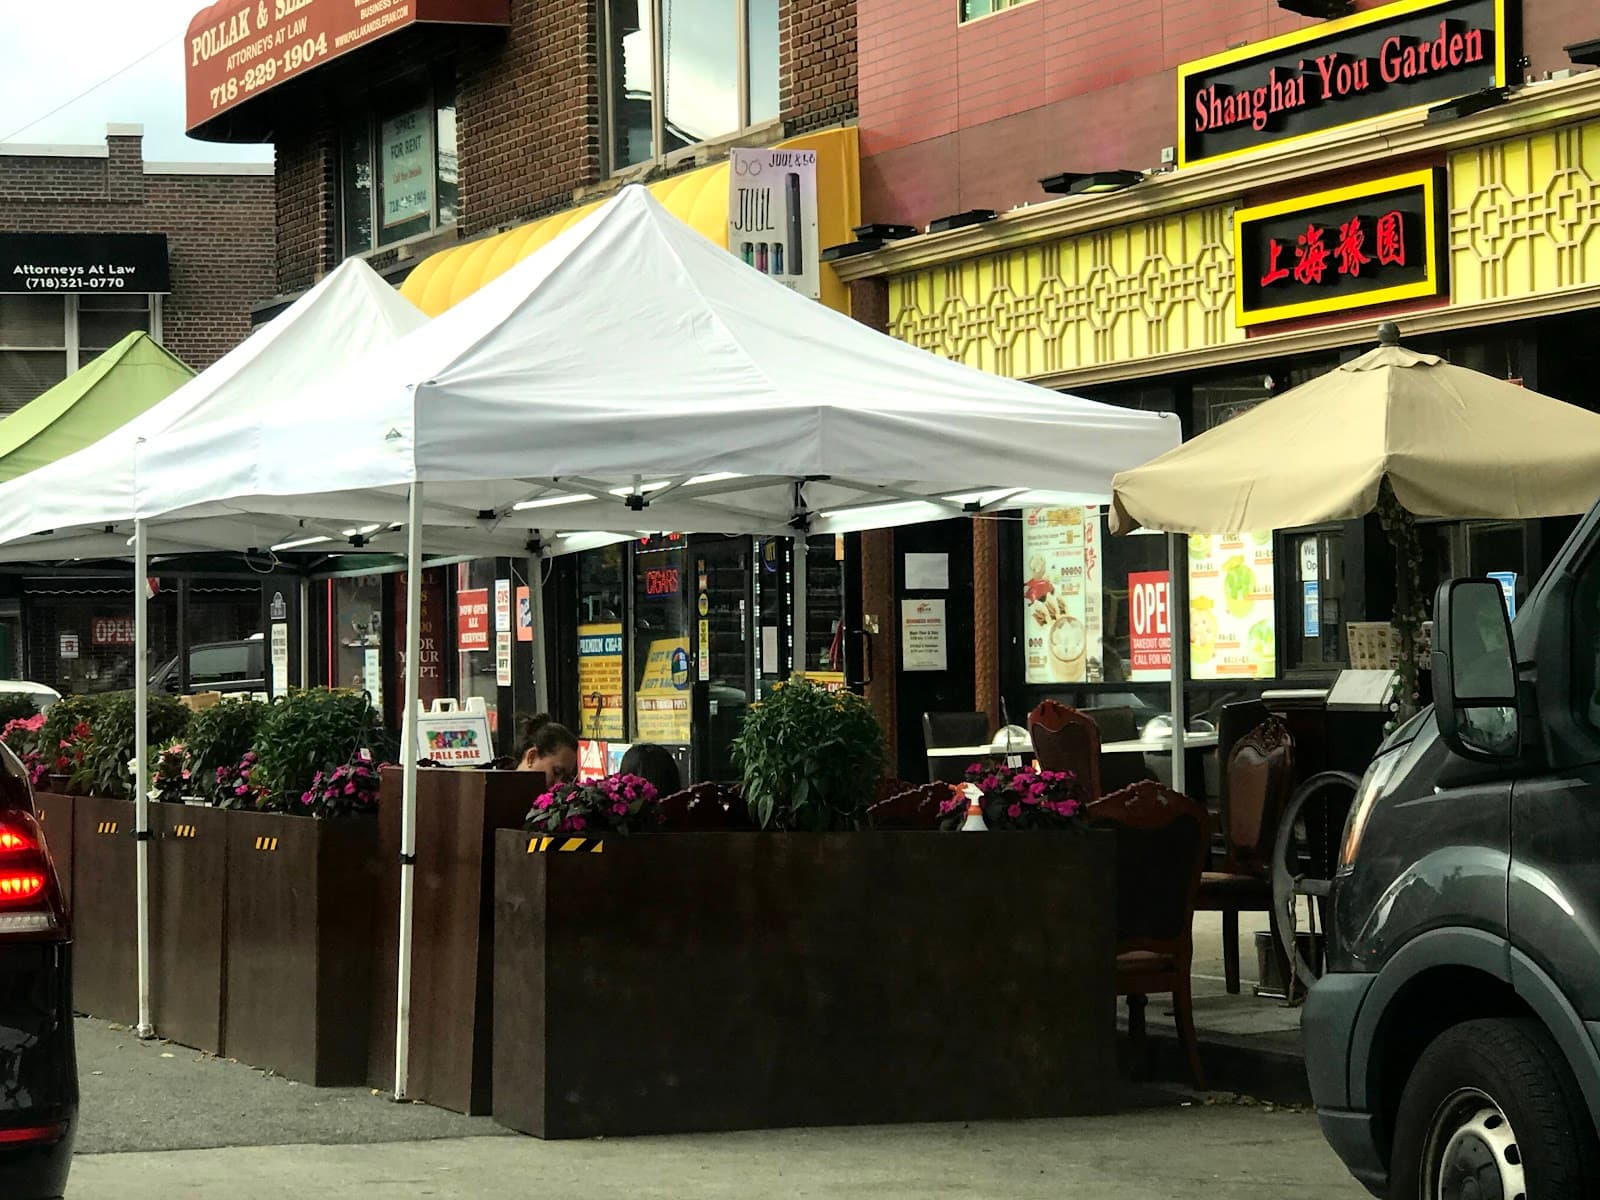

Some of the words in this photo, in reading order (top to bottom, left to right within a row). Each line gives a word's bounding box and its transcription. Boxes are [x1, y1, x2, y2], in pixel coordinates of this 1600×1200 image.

[191, 7, 251, 67] POLLAK
[257, 0, 269, 29] &
[226, 34, 273, 72] ATTORNEYS
[275, 26, 286, 47] AT
[287, 15, 308, 40] LAW
[210, 32, 328, 109] 718-229-1904
[1195, 59, 1305, 132] Shanghai
[1315, 52, 1369, 100] You
[1379, 20, 1484, 84] Garden
[390, 142, 404, 160] FOR
[405, 135, 422, 156] RENT
[769, 153, 793, 167] JUUL
[734, 187, 775, 232] JUUL
[1260, 210, 1406, 287] 上海豫園
[13, 264, 84, 276] Attorneys
[88, 264, 104, 274] At
[108, 264, 136, 274] Law
[26, 277, 124, 289] (718)321-0770
[646, 568, 679, 594] CIGARS
[95, 619, 137, 642] OPEN
[1133, 638, 1158, 649] TAKEOUT
[399, 650, 439, 662] YUR
[1134, 654, 1148, 665] CALL
[1148, 654, 1160, 665] FOR
[430, 751, 453, 760] FALL
[455, 750, 480, 759] SALE
